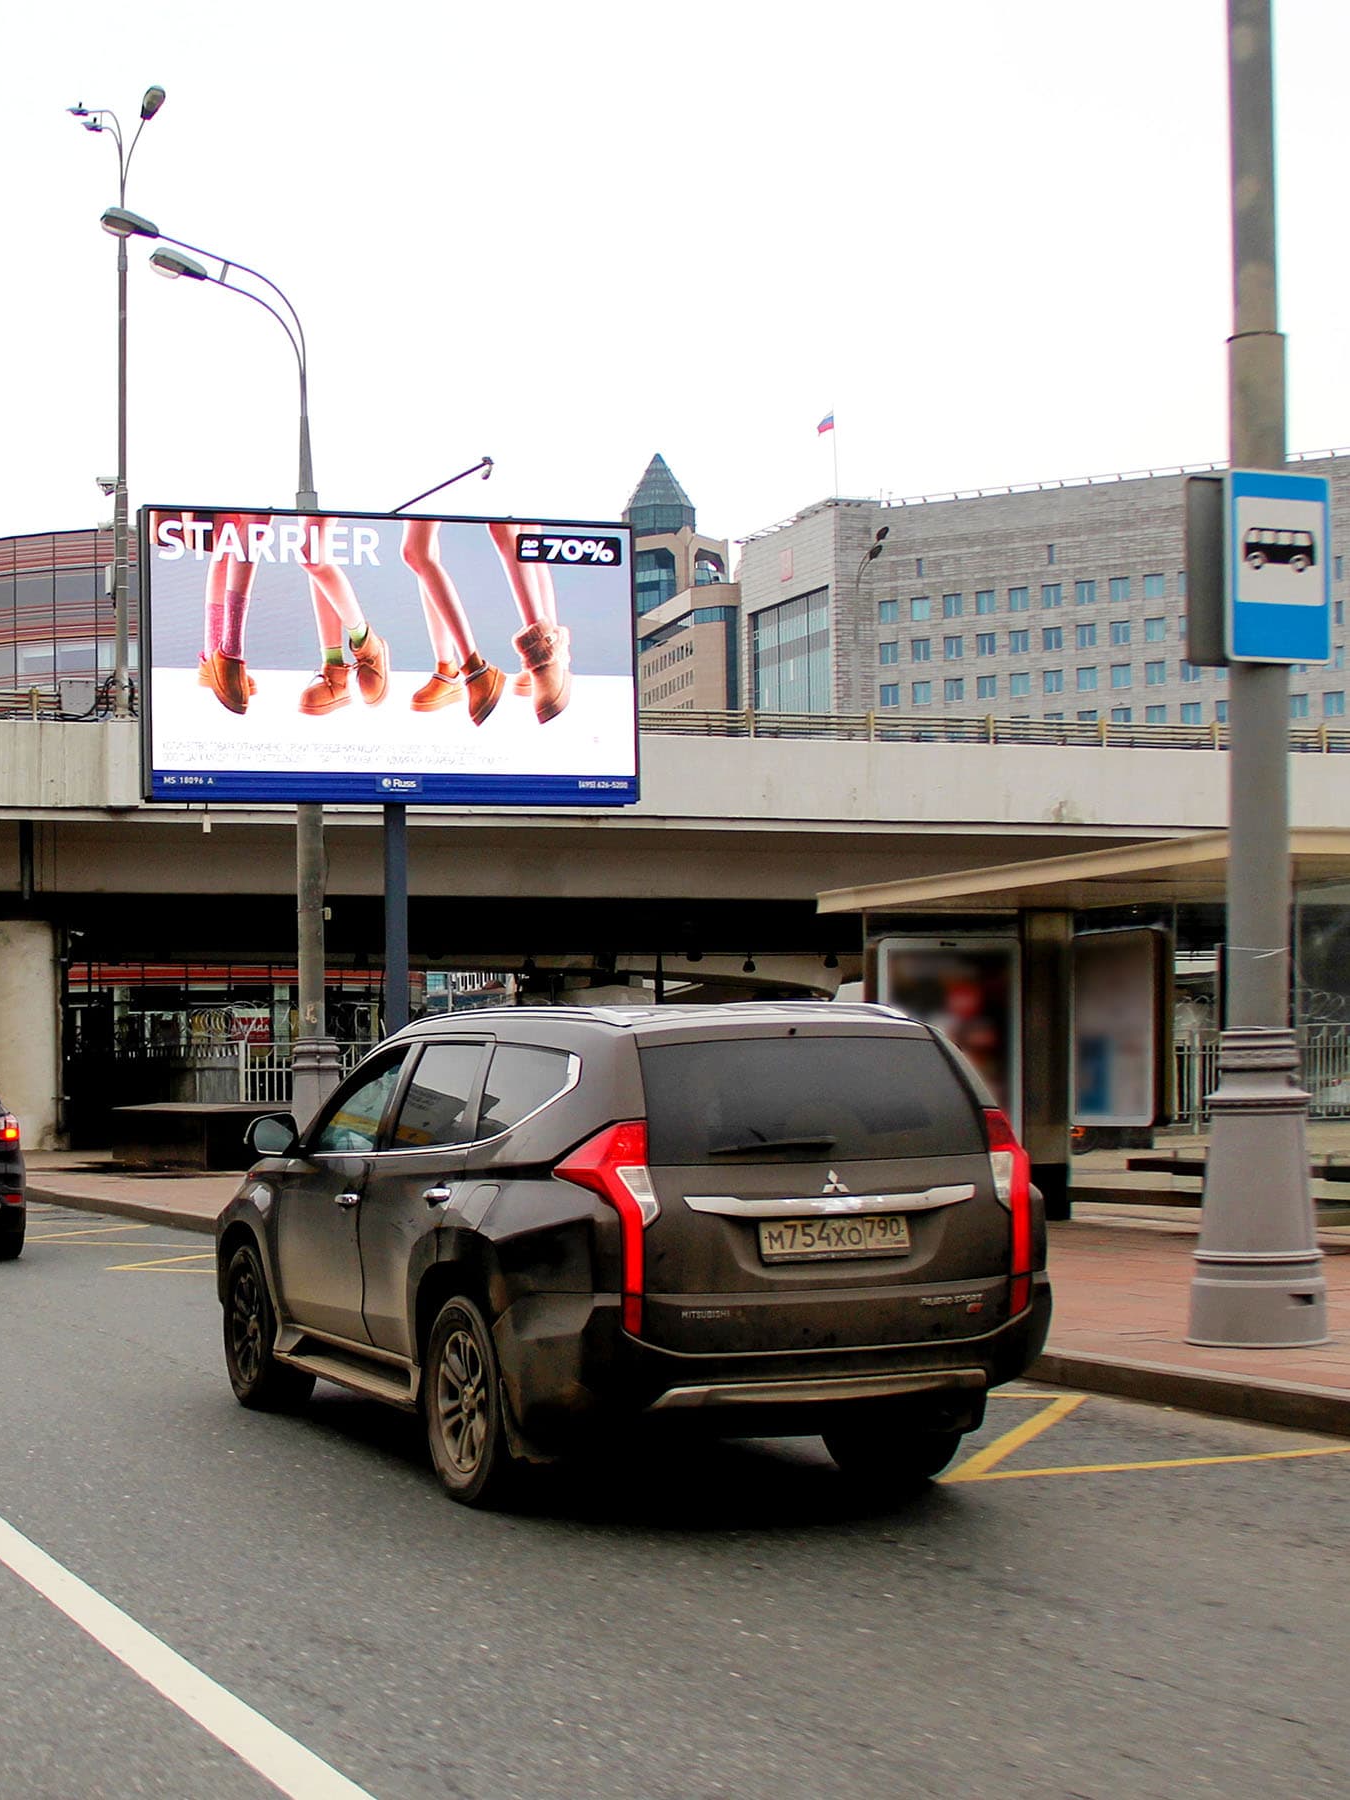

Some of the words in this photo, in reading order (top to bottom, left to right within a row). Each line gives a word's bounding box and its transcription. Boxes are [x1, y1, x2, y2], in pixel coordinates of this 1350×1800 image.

[157, 519, 381, 567] STARRIER
[393, 778, 417, 788] Russ
[681, 1310, 731, 1320] MITSUBISHI
